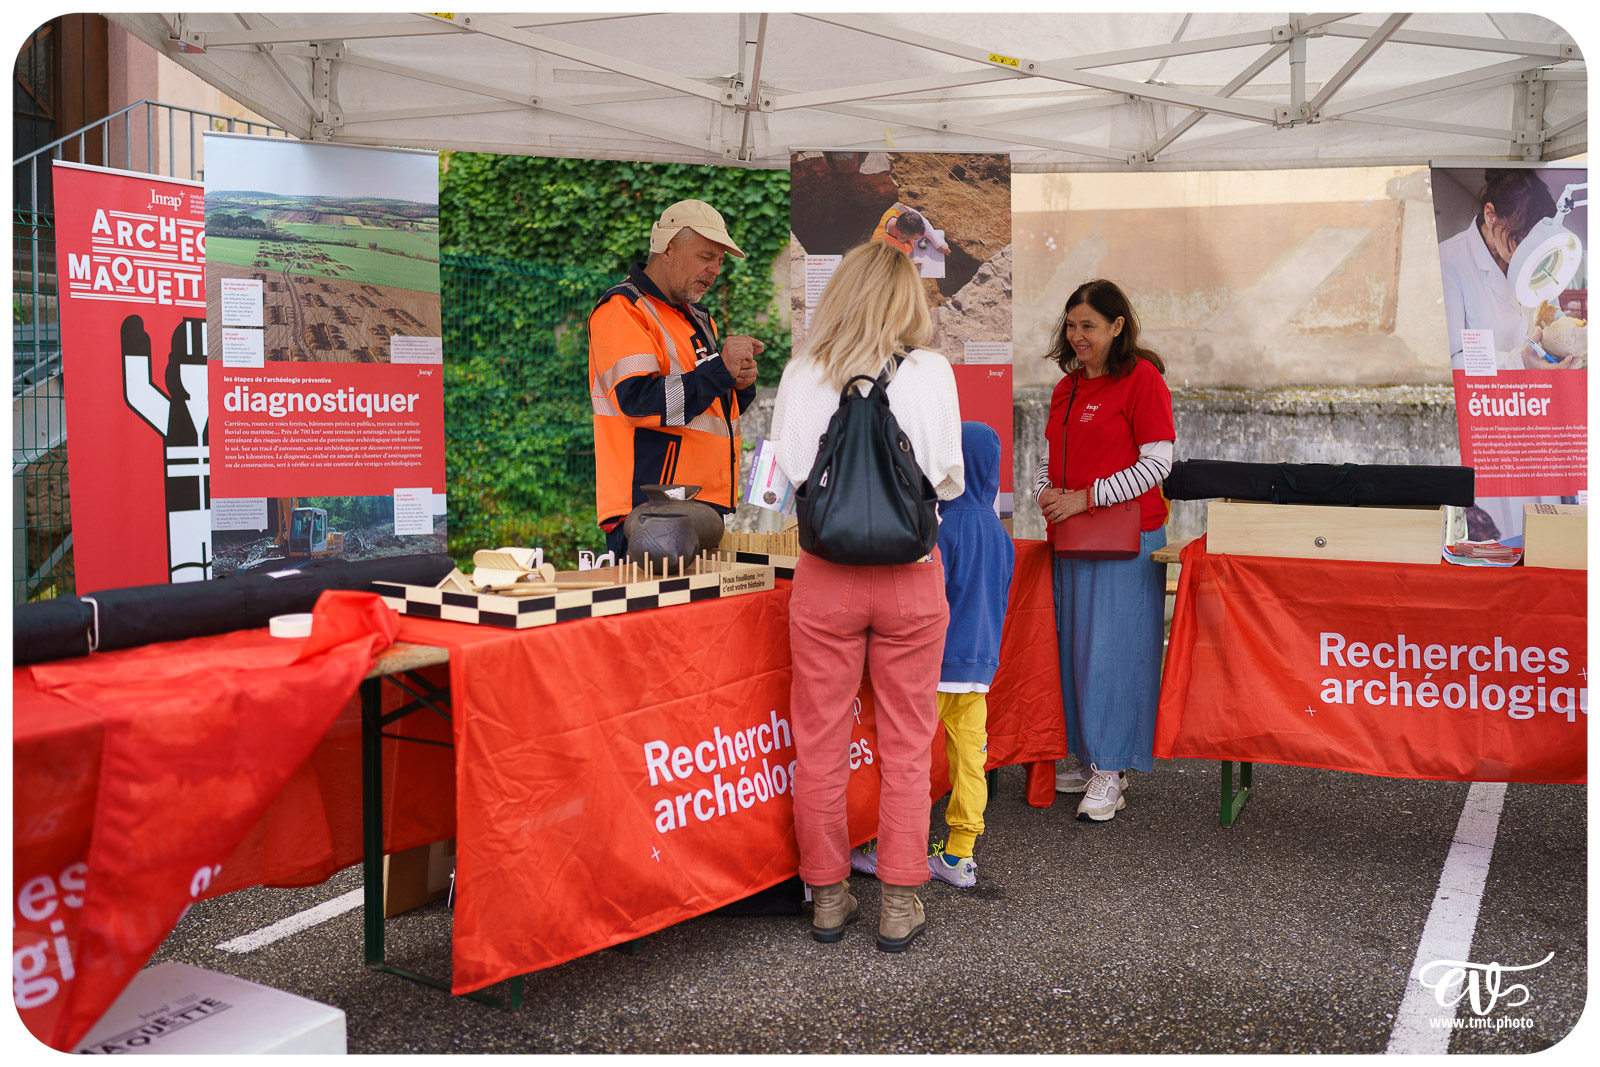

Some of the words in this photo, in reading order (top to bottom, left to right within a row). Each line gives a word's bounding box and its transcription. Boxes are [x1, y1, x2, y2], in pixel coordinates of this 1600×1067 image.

[151, 188, 182, 212] Inrap
[68, 253, 206, 304] MAQUETT
[224, 386, 420, 418] diagnostiquer
[1468, 392, 1551, 416] étudier
[736, 574, 755, 582] fouillons
[1320, 632, 1570, 674] Recherches
[644, 710, 793, 787] Recherch
